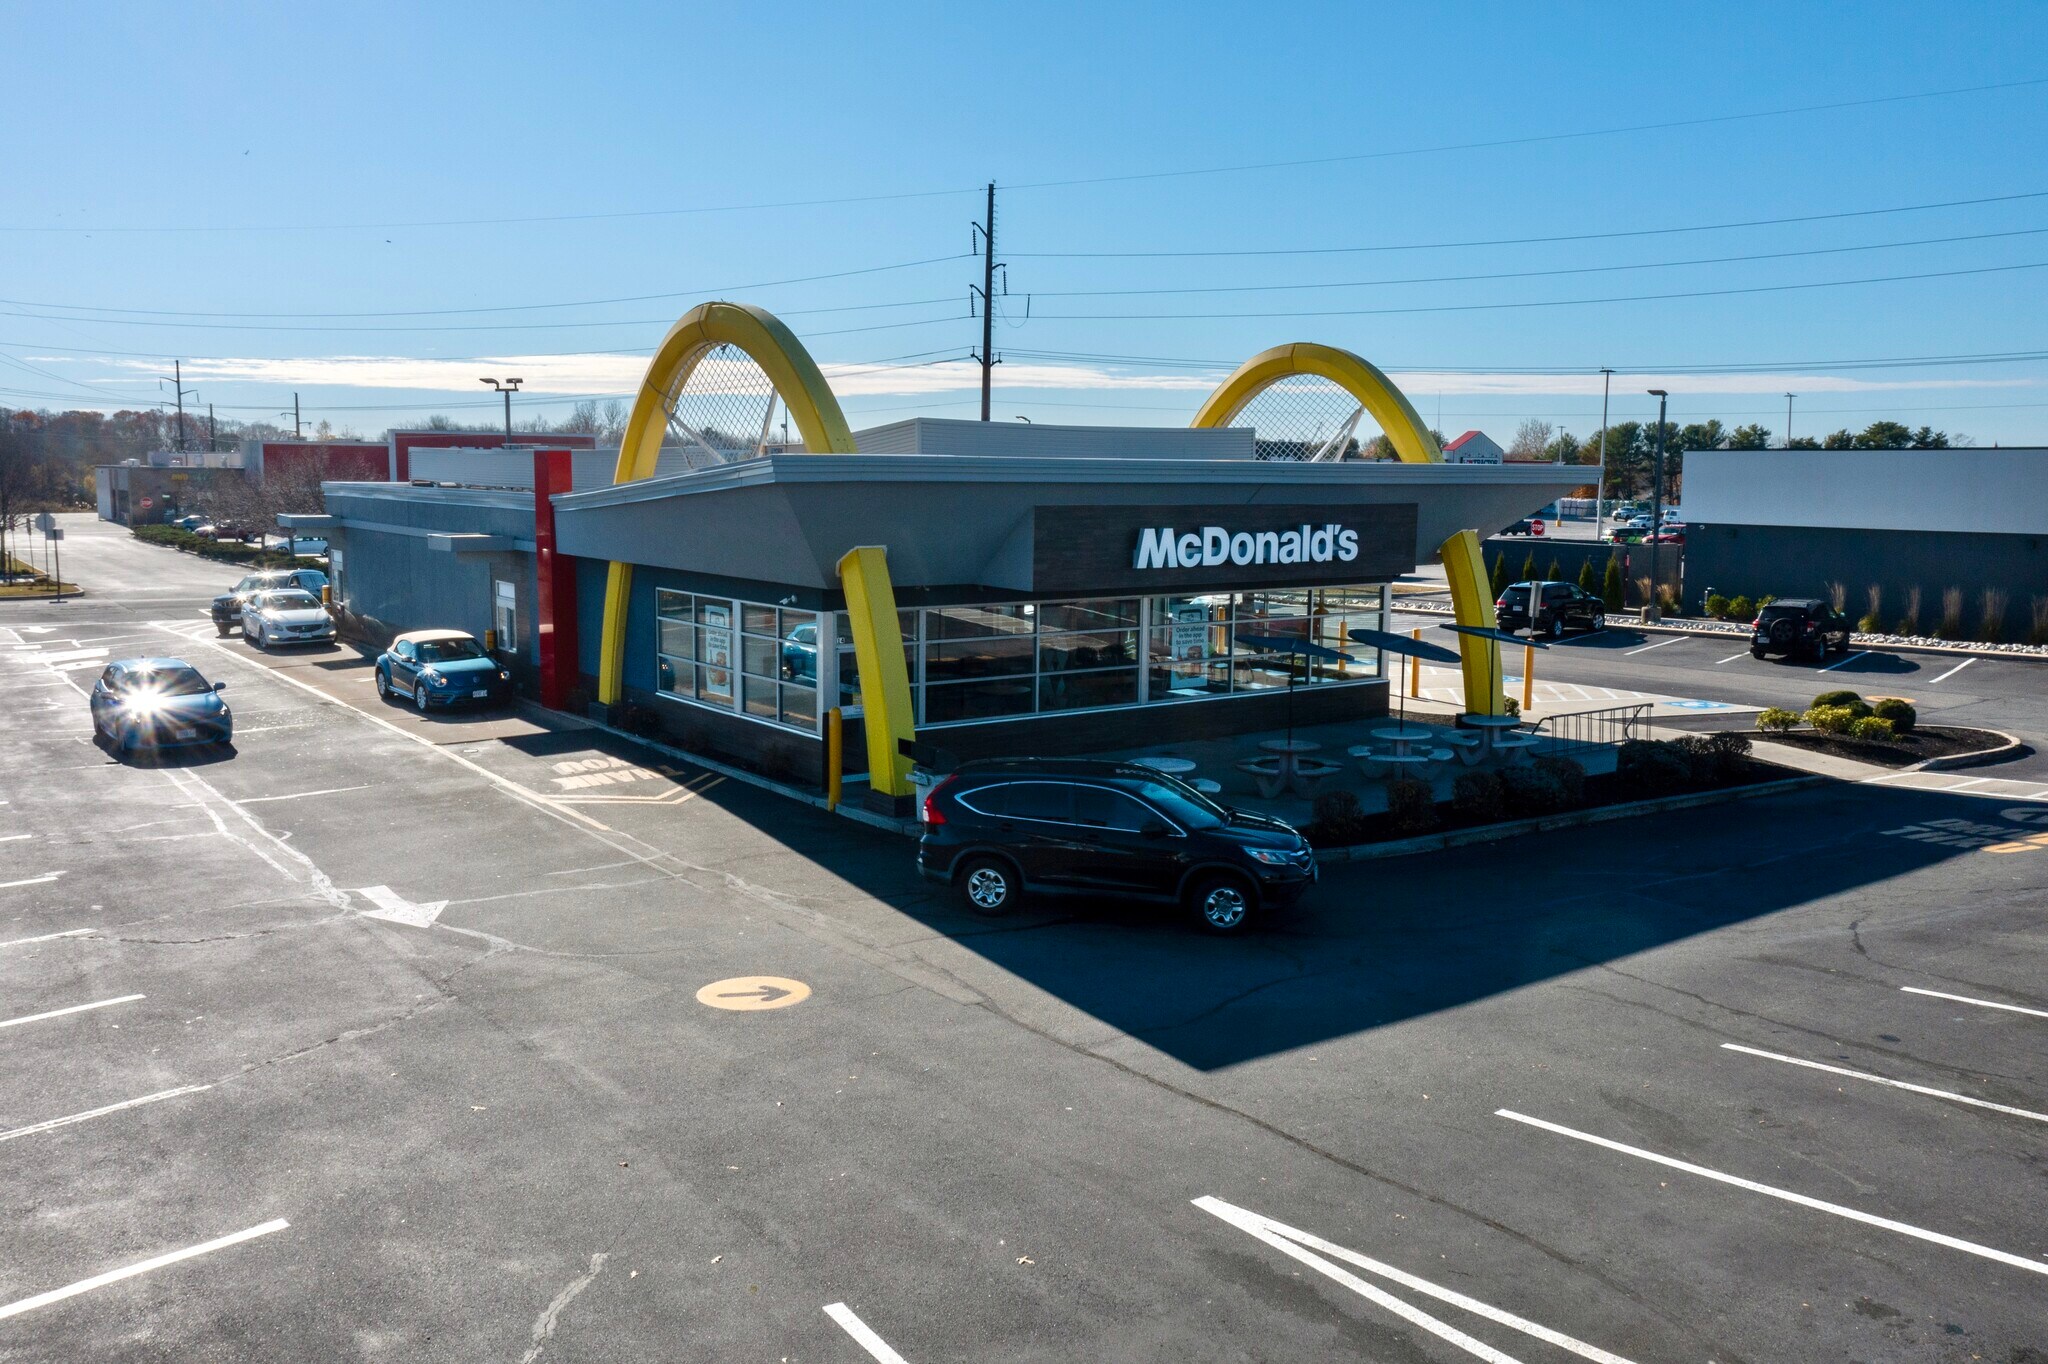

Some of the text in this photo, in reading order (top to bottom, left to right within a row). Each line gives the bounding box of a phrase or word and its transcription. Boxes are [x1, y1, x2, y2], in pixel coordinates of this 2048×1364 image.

[1532, 524, 1544, 532] STOP
[1134, 524, 1359, 569] McDonald's
[552, 756, 632, 775] YOU
